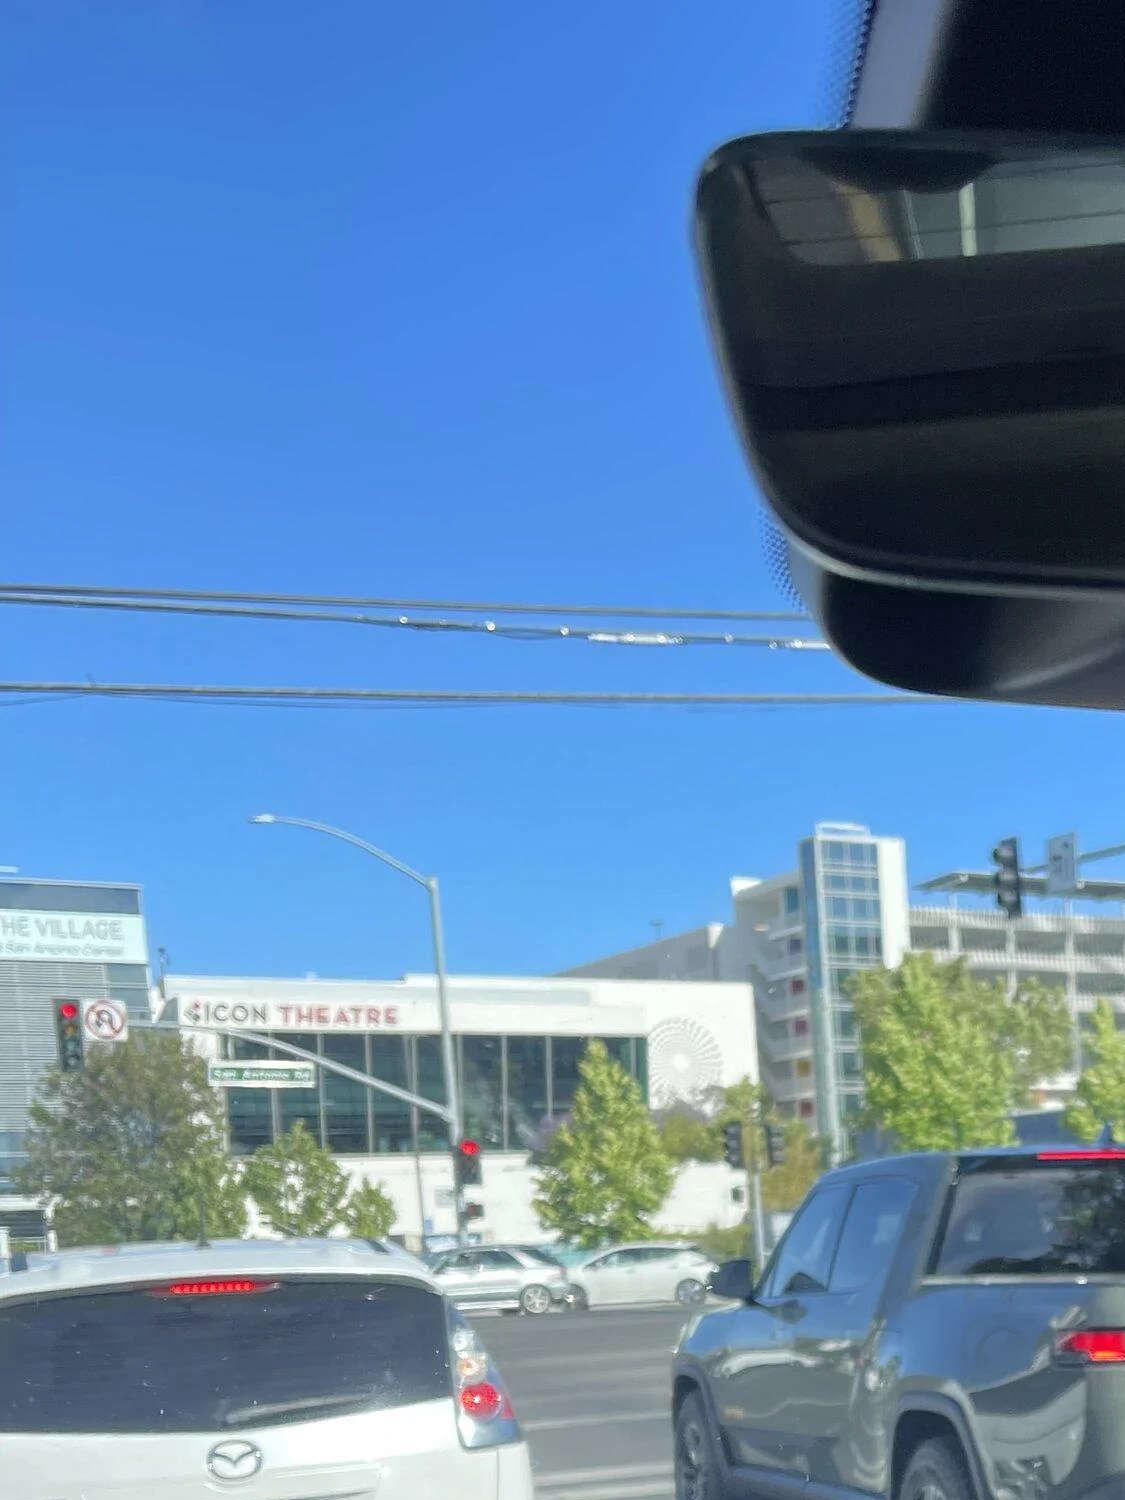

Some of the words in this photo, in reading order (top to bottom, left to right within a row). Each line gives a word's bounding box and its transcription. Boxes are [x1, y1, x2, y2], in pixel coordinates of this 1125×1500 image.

[0, 914, 31, 938] HE
[34, 917, 124, 940] VILLAGE
[203, 1003, 268, 1023] ICON
[278, 1004, 399, 1026] THEATRE
[213, 1069, 236, 1080] San
